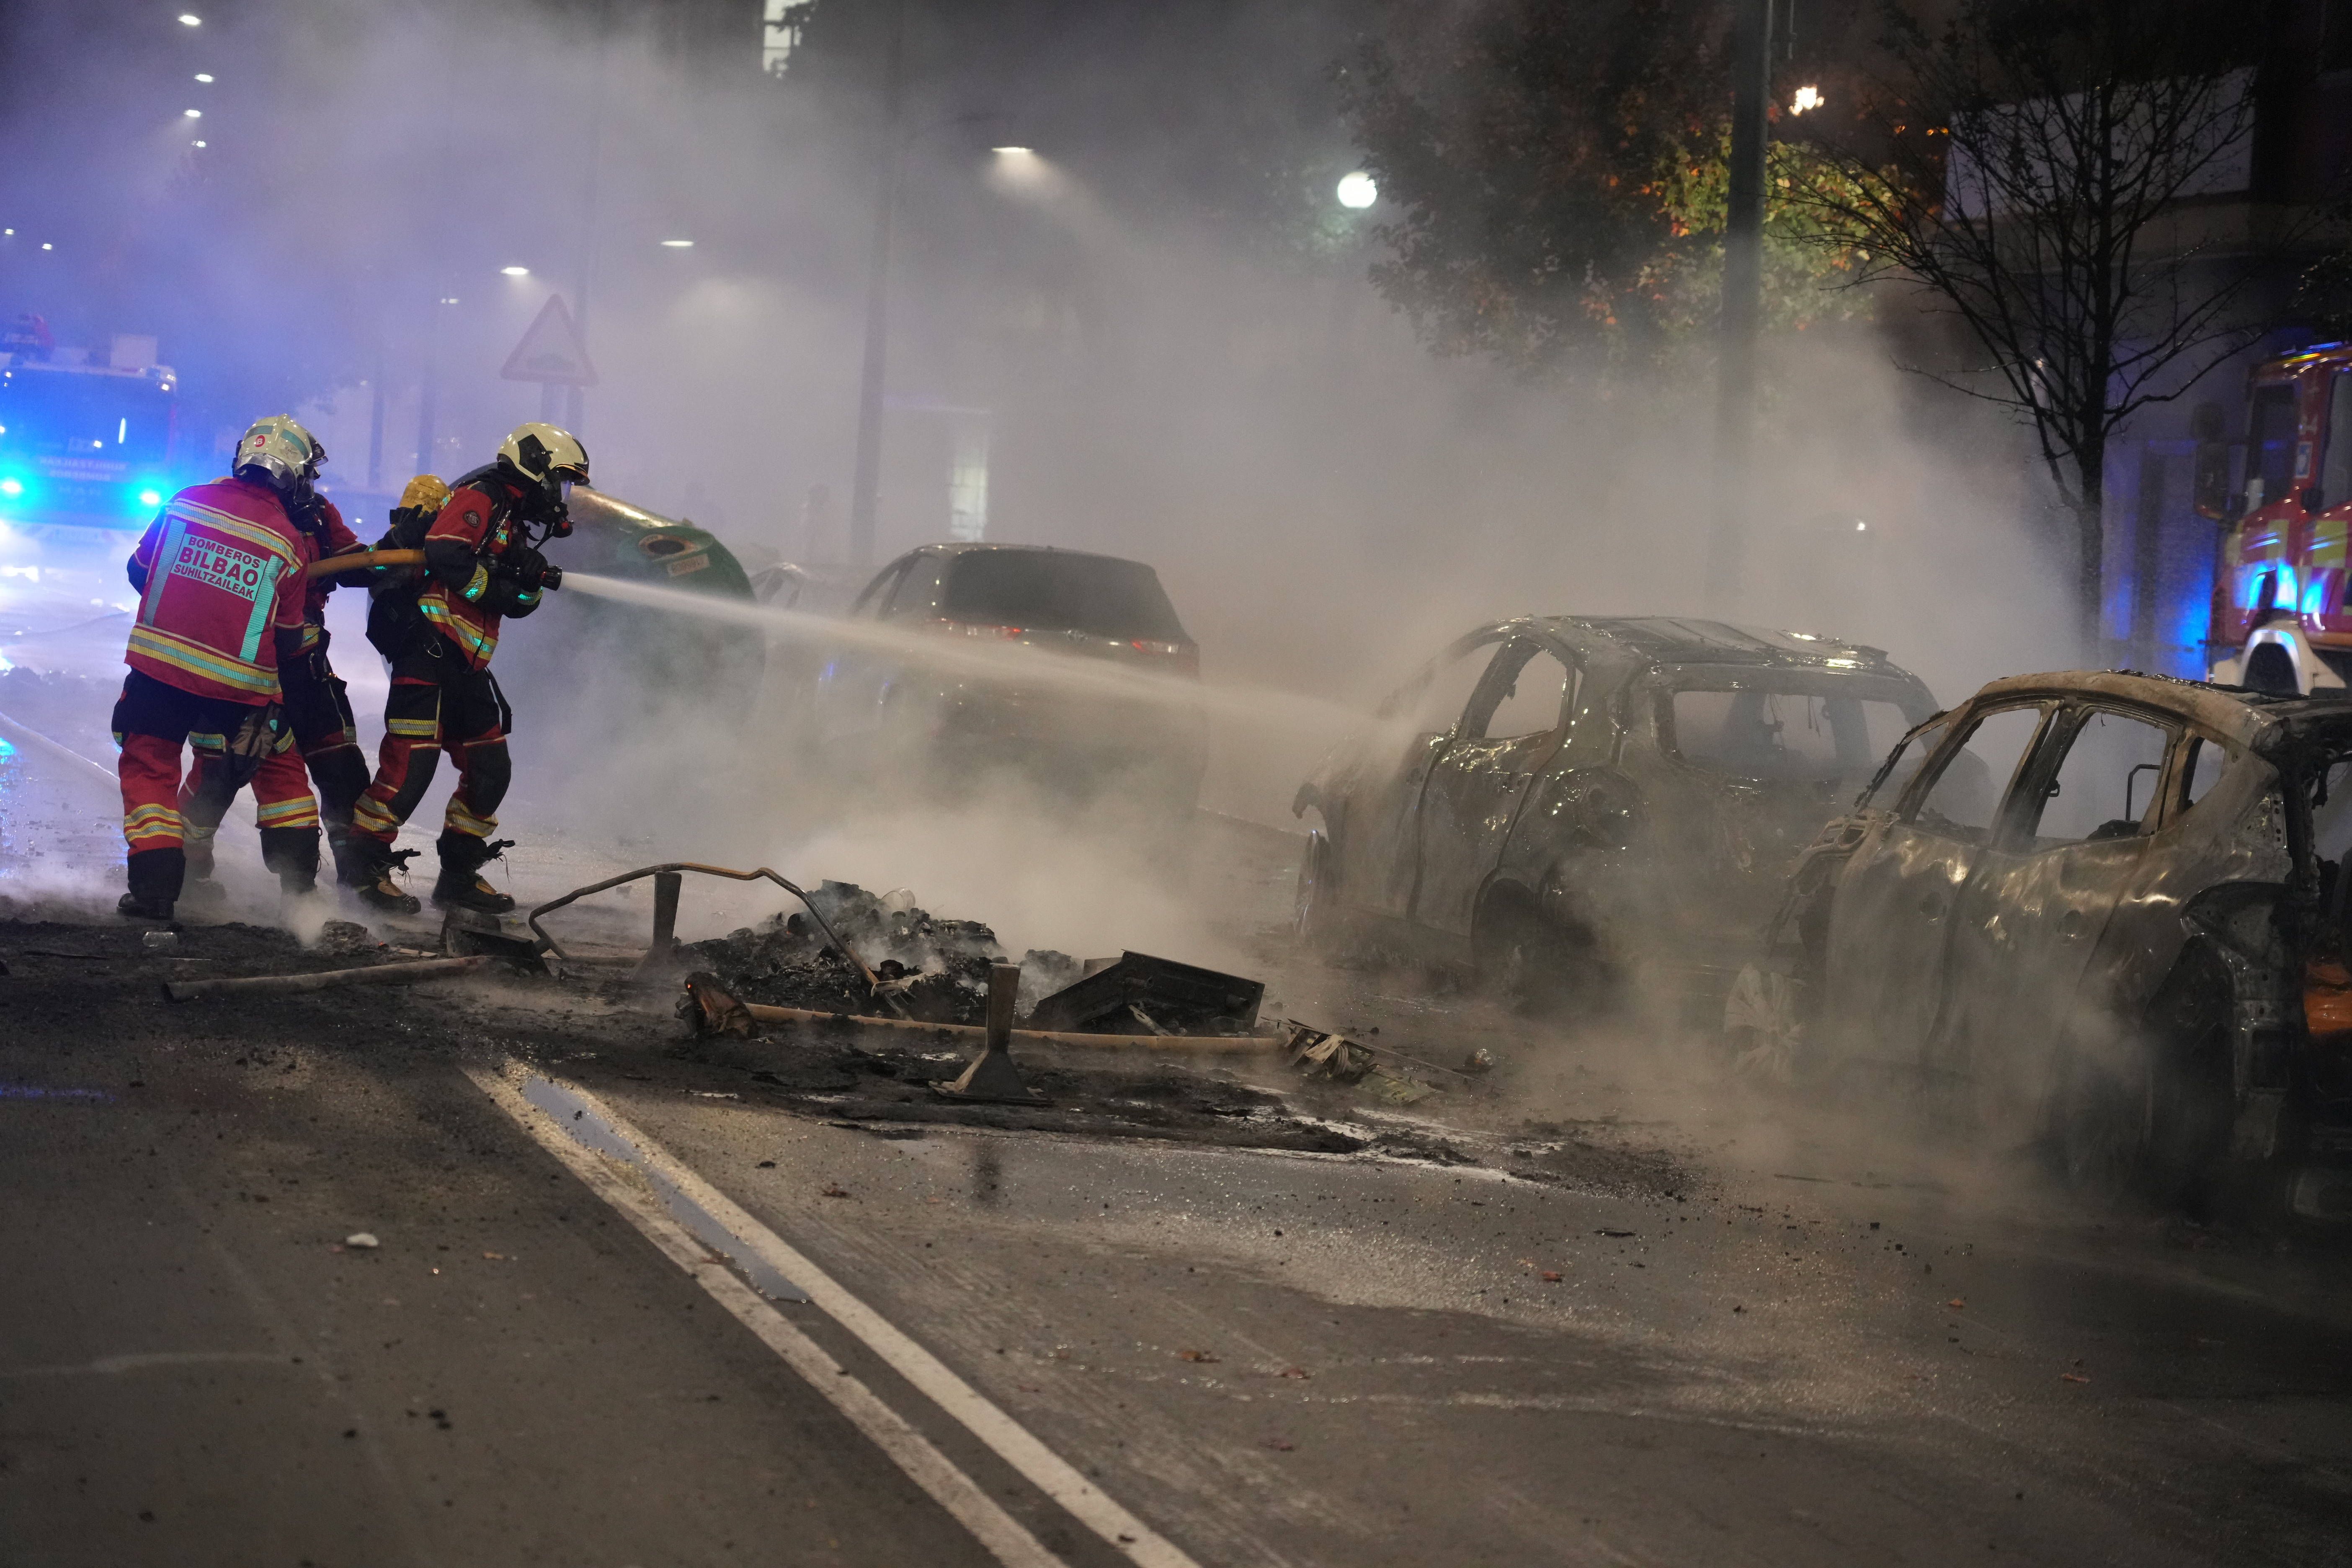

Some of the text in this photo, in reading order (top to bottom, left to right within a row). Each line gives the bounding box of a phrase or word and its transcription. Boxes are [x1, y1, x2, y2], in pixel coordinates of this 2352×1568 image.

[179, 547, 258, 586] BILBAO
[188, 536, 260, 568] BOMBEROS
[174, 564, 254, 599] SUHILTZAILEAK
